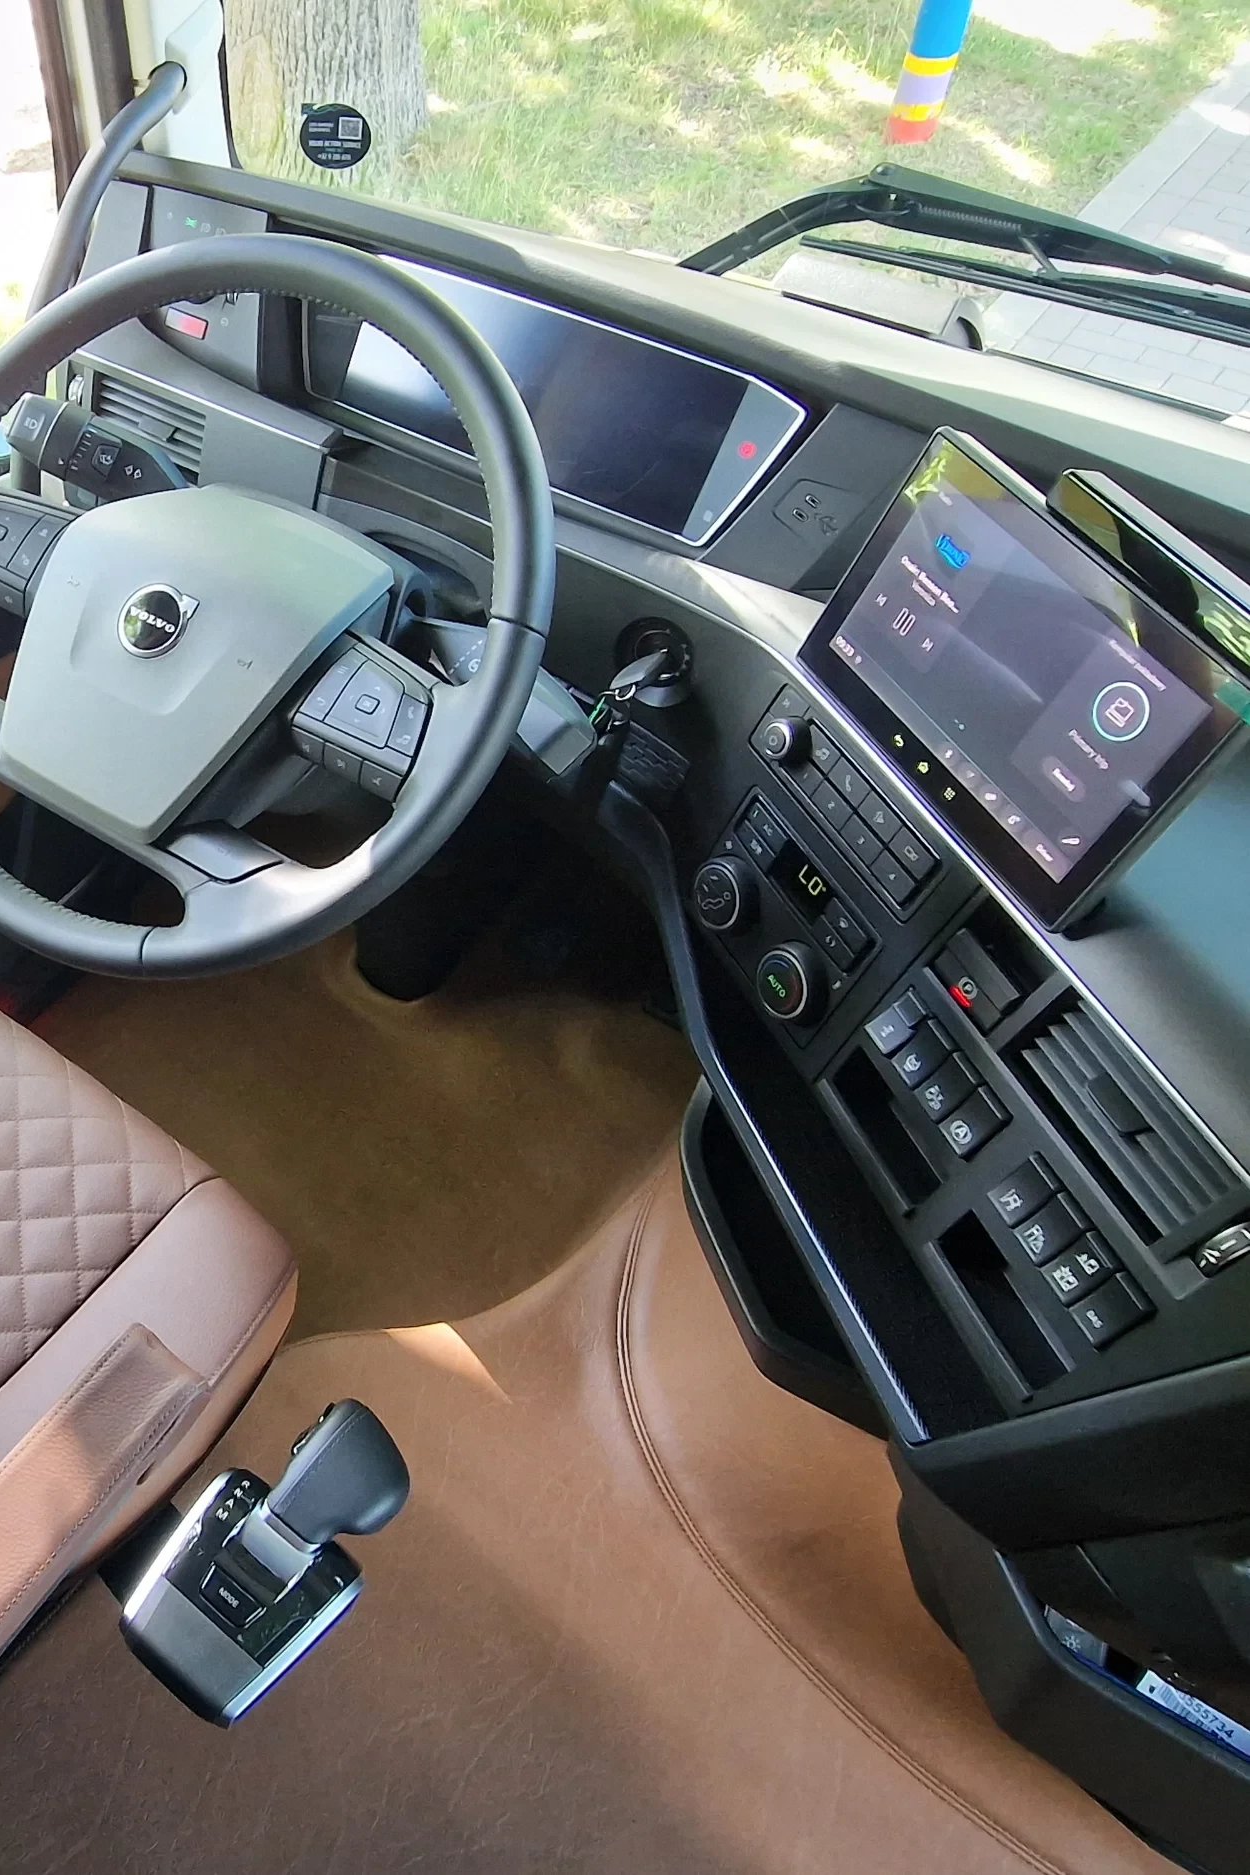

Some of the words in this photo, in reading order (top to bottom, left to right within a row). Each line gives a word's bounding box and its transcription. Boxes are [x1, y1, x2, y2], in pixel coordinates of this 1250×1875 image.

[129, 605, 176, 634] VOLVO
[768, 974, 786, 998] AUTO
[241, 1479, 250, 1489] R
[233, 1487, 244, 1498] N
[225, 1498, 235, 1510] A
[215, 1507, 229, 1522] M
[218, 1586, 240, 1609] MODE
